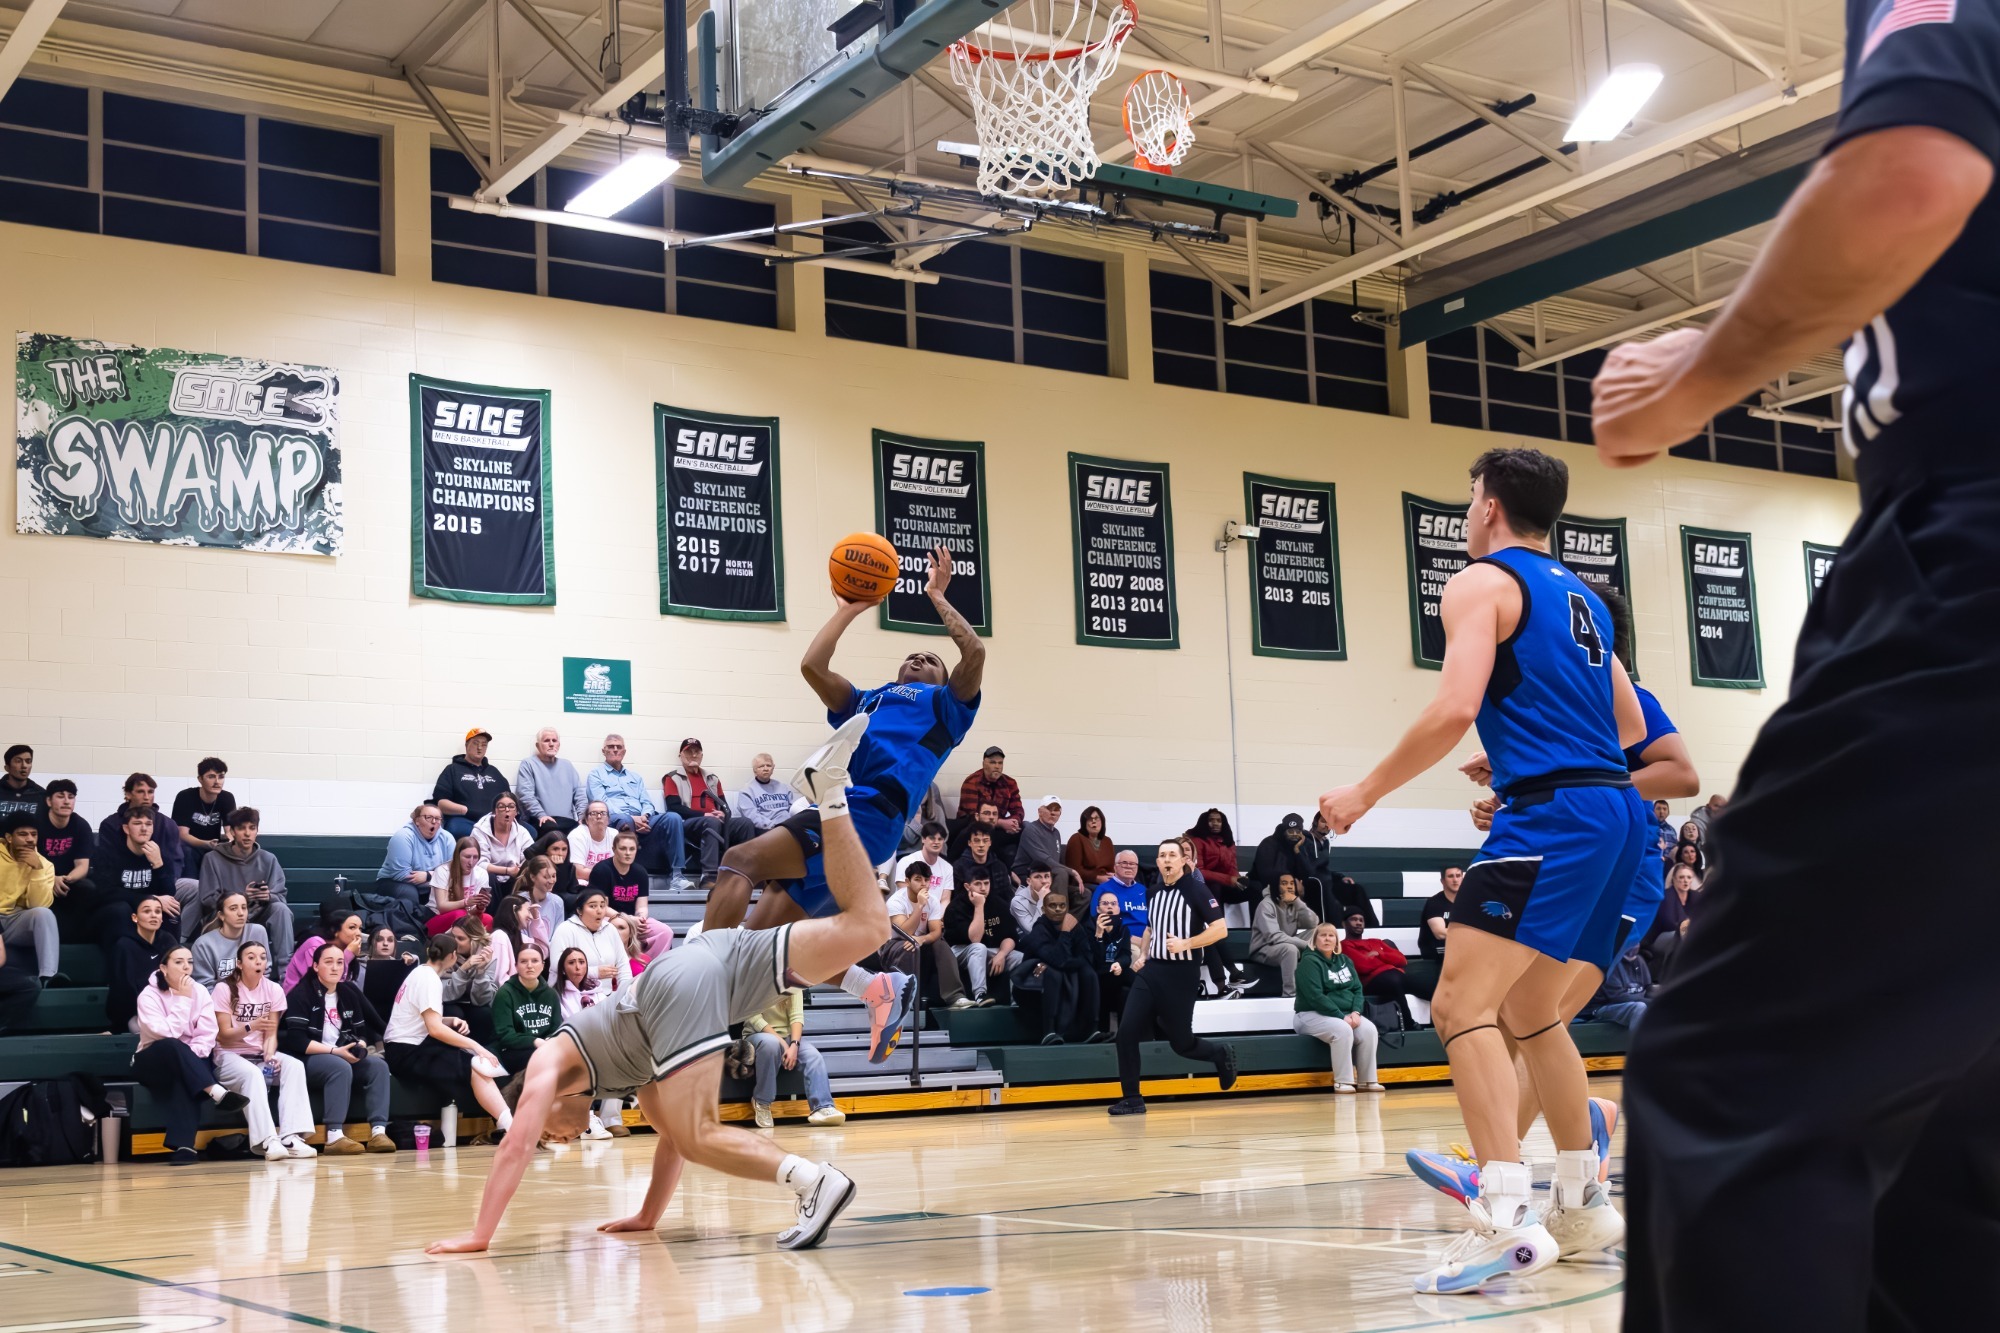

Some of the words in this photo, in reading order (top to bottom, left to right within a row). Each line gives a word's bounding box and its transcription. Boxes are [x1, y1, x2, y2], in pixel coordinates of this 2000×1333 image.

[45, 353, 124, 406] THE
[178, 373, 289, 416] SAGE
[433, 401, 525, 436] SAGE
[460, 435, 512, 447] BASKETBALL
[676, 429, 756, 462] SAGE
[44, 417, 322, 531] SWAMP
[453, 457, 512, 475] SKYLINE
[676, 457, 698, 467] MEN'S
[699, 461, 745, 472] BASKETBALL
[892, 454, 964, 484] SAGE
[435, 471, 531, 493] TOURNAMENT
[693, 482, 746, 499] SKYLINE
[893, 481, 922, 491] WOMEN'S
[924, 486, 965, 495] VOLLEYBALL
[1086, 475, 1152, 503] SAGE
[432, 488, 535, 513] CHAMPIONS
[680, 496, 761, 515] CONFERENCE
[1087, 502, 1115, 511] WOMEN'S
[1115, 504, 1152, 514] VOLLEYBALL
[1261, 493, 1320, 521] SAGE
[908, 504, 957, 519] SKYLINE
[433, 513, 482, 535] 2015
[674, 512, 767, 534] CHAMPIONS
[893, 518, 972, 535] TOURNAMENT
[1102, 523, 1145, 537] SKYLINE
[676, 535, 720, 556] 2015
[893, 532, 975, 553] CHAMPIONS
[1091, 537, 1157, 553] CONFERENCE
[1275, 540, 1314, 553] SKYLINE
[1436, 540, 1458, 548] SOCCER
[1563, 530, 1613, 555] SAGE
[678, 554, 720, 574] 2017
[725, 559, 753, 569] NORTH
[844, 548, 889, 573] Wilson
[1087, 551, 1162, 569] CHAMPIONS
[1264, 553, 1325, 568] CONFERENCE
[1694, 543, 1740, 566] SAGE
[725, 567, 754, 577] DIVISION
[898, 555, 932, 573] 2007
[950, 560, 976, 576] 008
[1263, 566, 1329, 584] CHAMPIONS
[1090, 572, 1124, 589] 2007
[1130, 575, 1164, 592] 2008
[1706, 584, 1737, 596] SKYLINE
[1091, 594, 1126, 611] 2013
[1131, 597, 1164, 613] 2014
[1264, 586, 1293, 603] 2013
[1302, 590, 1330, 606] 2015
[1699, 595, 1746, 608] CONFERENCE
[1698, 607, 1750, 622] CHAMPIONS
[1092, 616, 1127, 633] 2015
[1568, 591, 1607, 667] 4
[1700, 624, 1723, 639] 2014
[583, 680, 612, 691] SAGE
